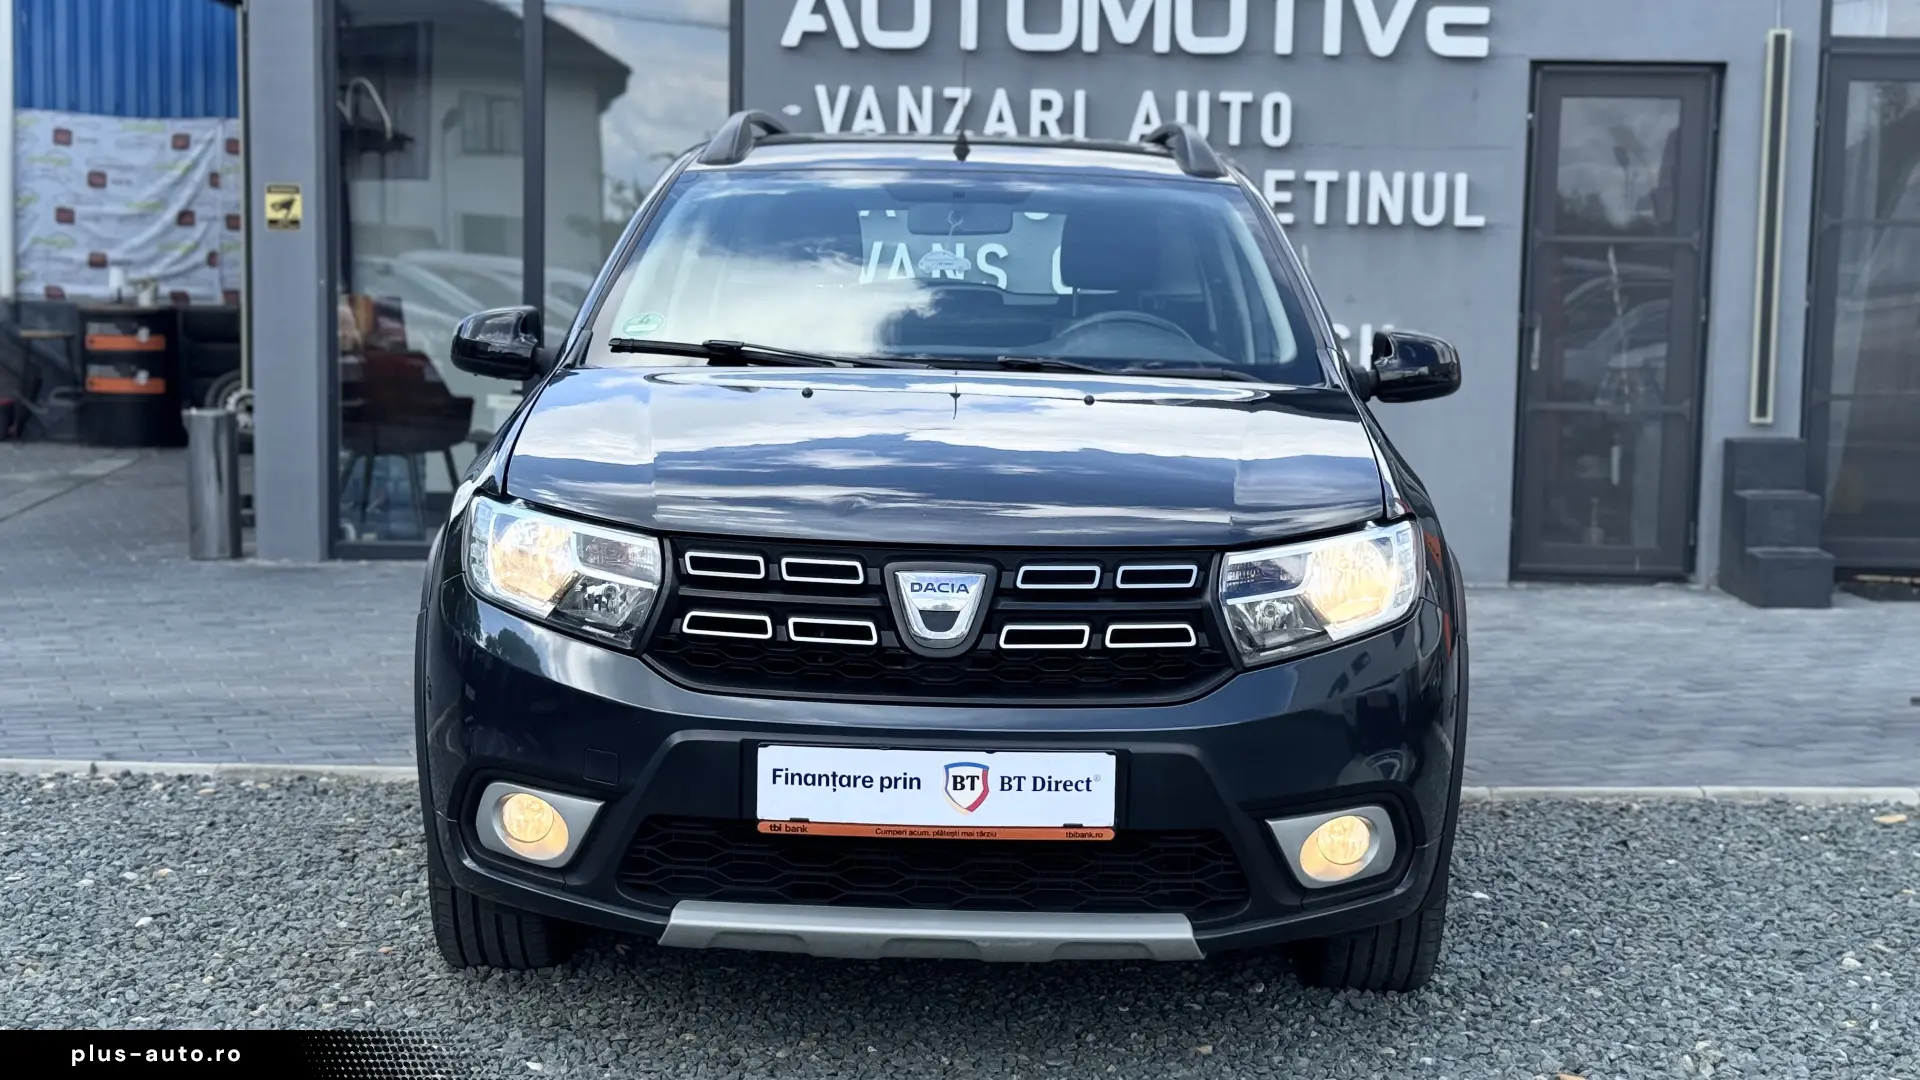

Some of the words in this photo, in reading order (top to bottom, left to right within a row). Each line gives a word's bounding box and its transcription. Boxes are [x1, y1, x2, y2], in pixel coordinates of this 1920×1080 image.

[1128, 90, 1293, 147] AUTO
[910, 582, 970, 594] DACIA
[772, 768, 874, 793] Finanțare
[880, 772, 922, 793] prin
[951, 774, 980, 791] BT
[999, 775, 1026, 792] BT
[769, 823, 782, 832] tbi
[785, 824, 808, 833] bank
[875, 828, 907, 837] Cumperi
[1065, 831, 1104, 839] tbibank.ro
